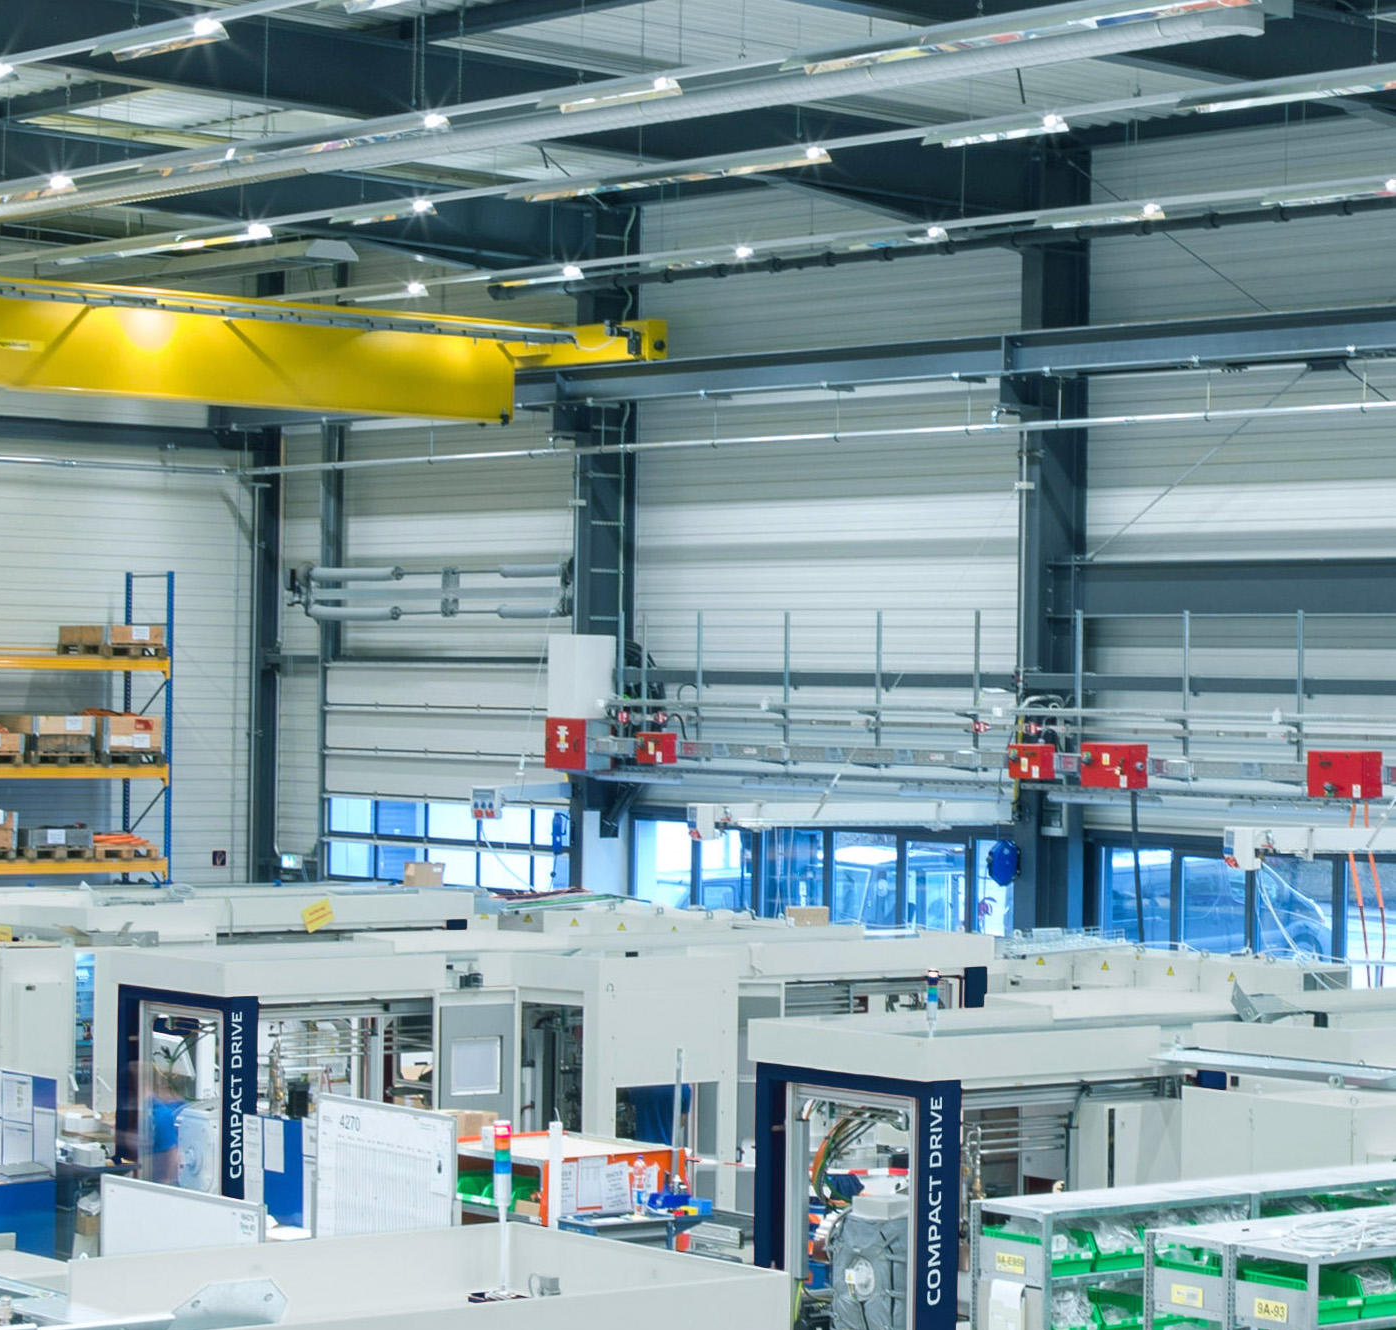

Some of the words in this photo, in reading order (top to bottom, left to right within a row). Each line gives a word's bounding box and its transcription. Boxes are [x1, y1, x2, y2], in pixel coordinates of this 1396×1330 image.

[230, 1010, 244, 1069] DRIVE
[229, 1076, 244, 1180] COMPACT
[929, 1096, 944, 1168] DRIVE
[926, 1175, 943, 1307] COMPACT
